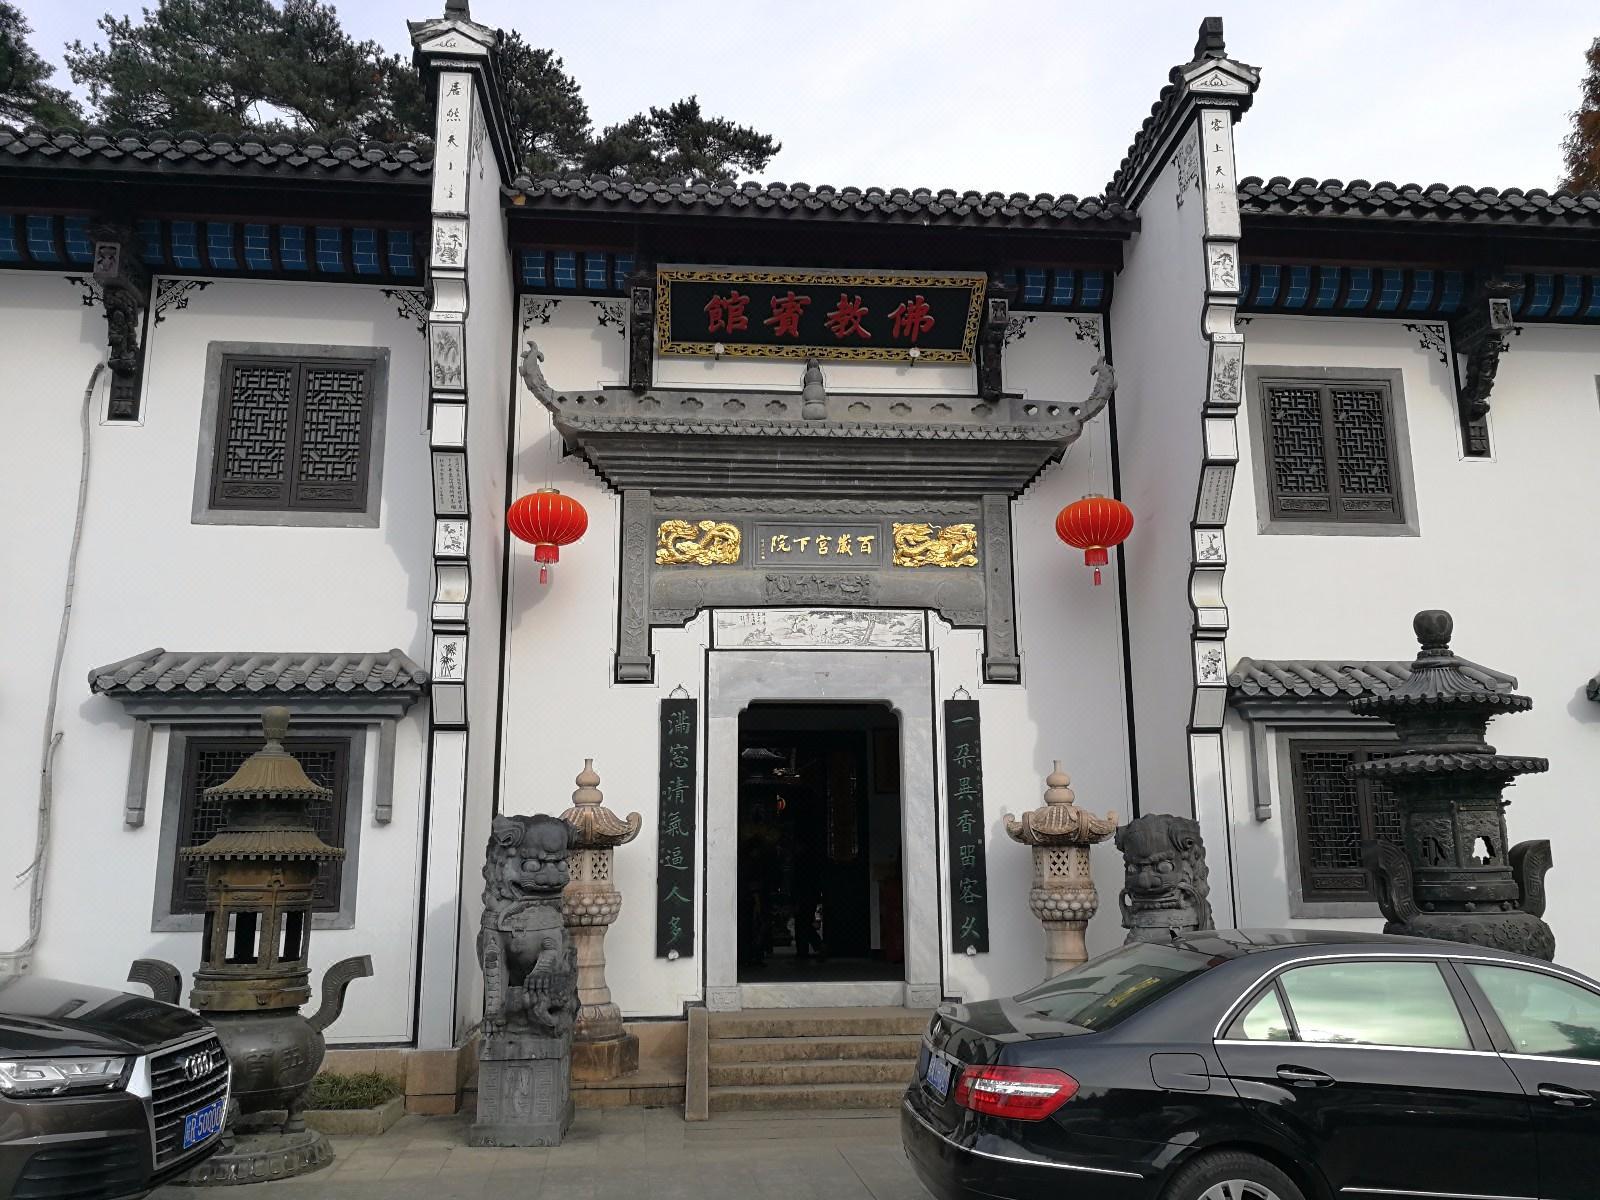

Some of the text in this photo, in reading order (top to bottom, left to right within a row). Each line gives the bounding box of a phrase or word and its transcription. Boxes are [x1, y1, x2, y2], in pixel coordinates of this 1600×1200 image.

[444, 81, 461, 199] 居然天
[1210, 118, 1227, 214] 客上天然
